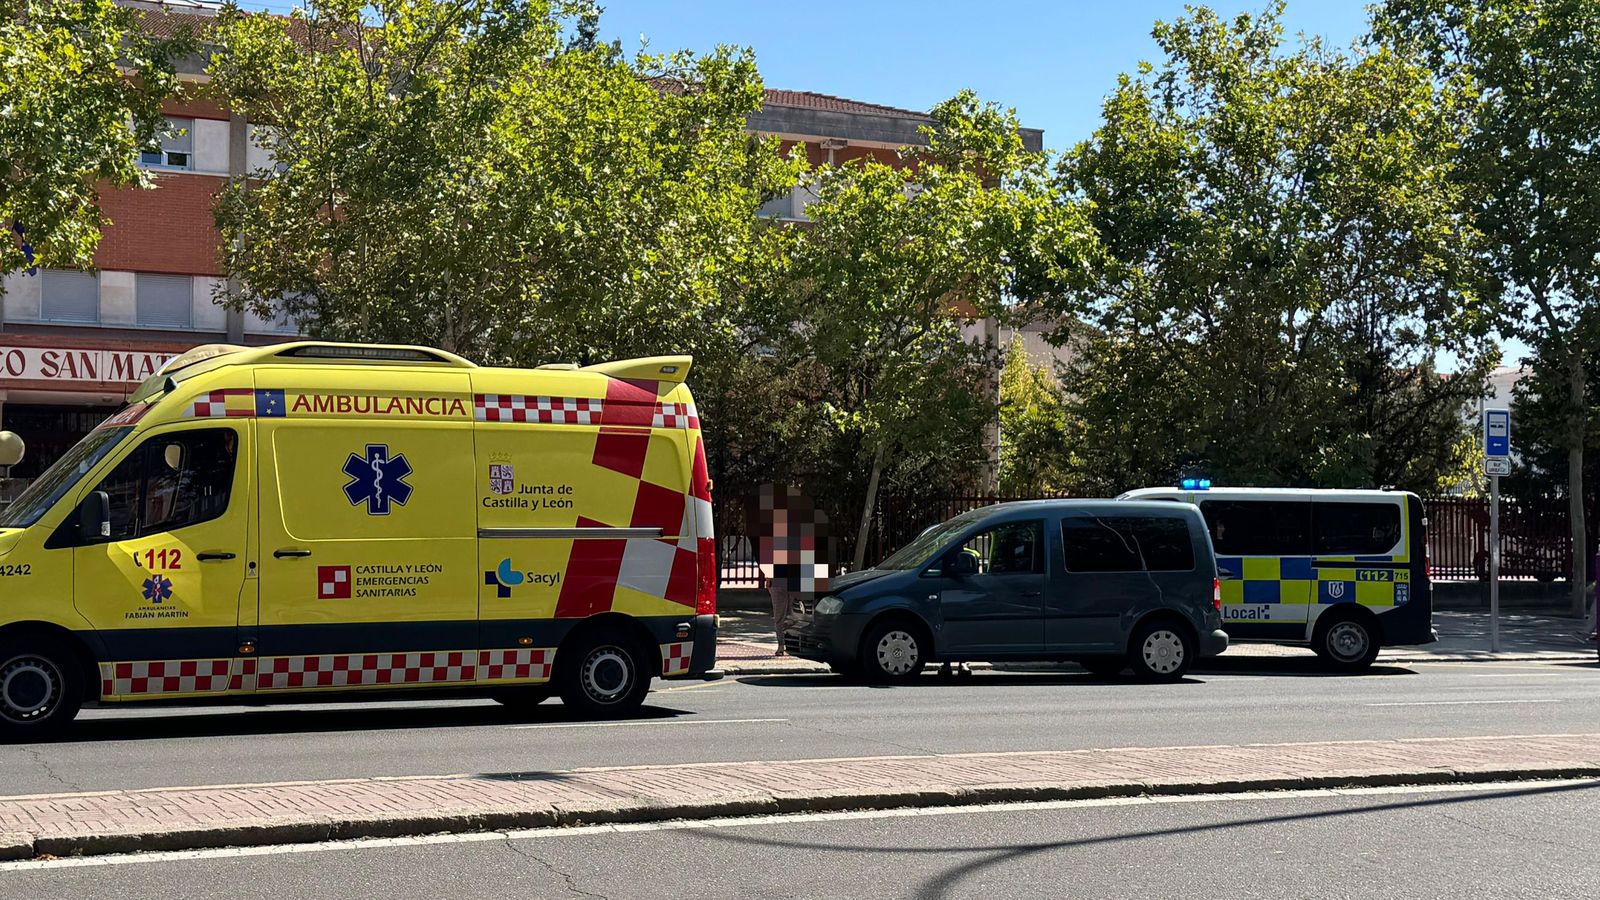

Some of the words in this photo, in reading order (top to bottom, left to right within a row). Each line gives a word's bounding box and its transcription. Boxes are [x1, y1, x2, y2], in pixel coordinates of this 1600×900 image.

[0, 349, 26, 377] O
[40, 350, 98, 379] SAN
[108, 352, 176, 380] MAT
[291, 393, 467, 416] AMBULANCIA
[518, 483, 554, 494] Junta
[557, 484, 573, 494] de
[482, 497, 529, 508] Castilla
[531, 499, 539, 511] y
[542, 497, 573, 508] León
[145, 548, 182, 570] 112
[0, 564, 31, 577] 4242
[355, 565, 404, 574] CASTILLA
[405, 564, 412, 574] Y
[414, 563, 442, 573] LEÓN
[356, 576, 429, 586] EMERGENCIAS
[527, 571, 560, 587] Sacyl
[1364, 570, 1389, 581] 112
[1394, 572, 1409, 580] 715
[355, 588, 417, 598] SANITARIAS
[1224, 606, 1261, 619] Local
